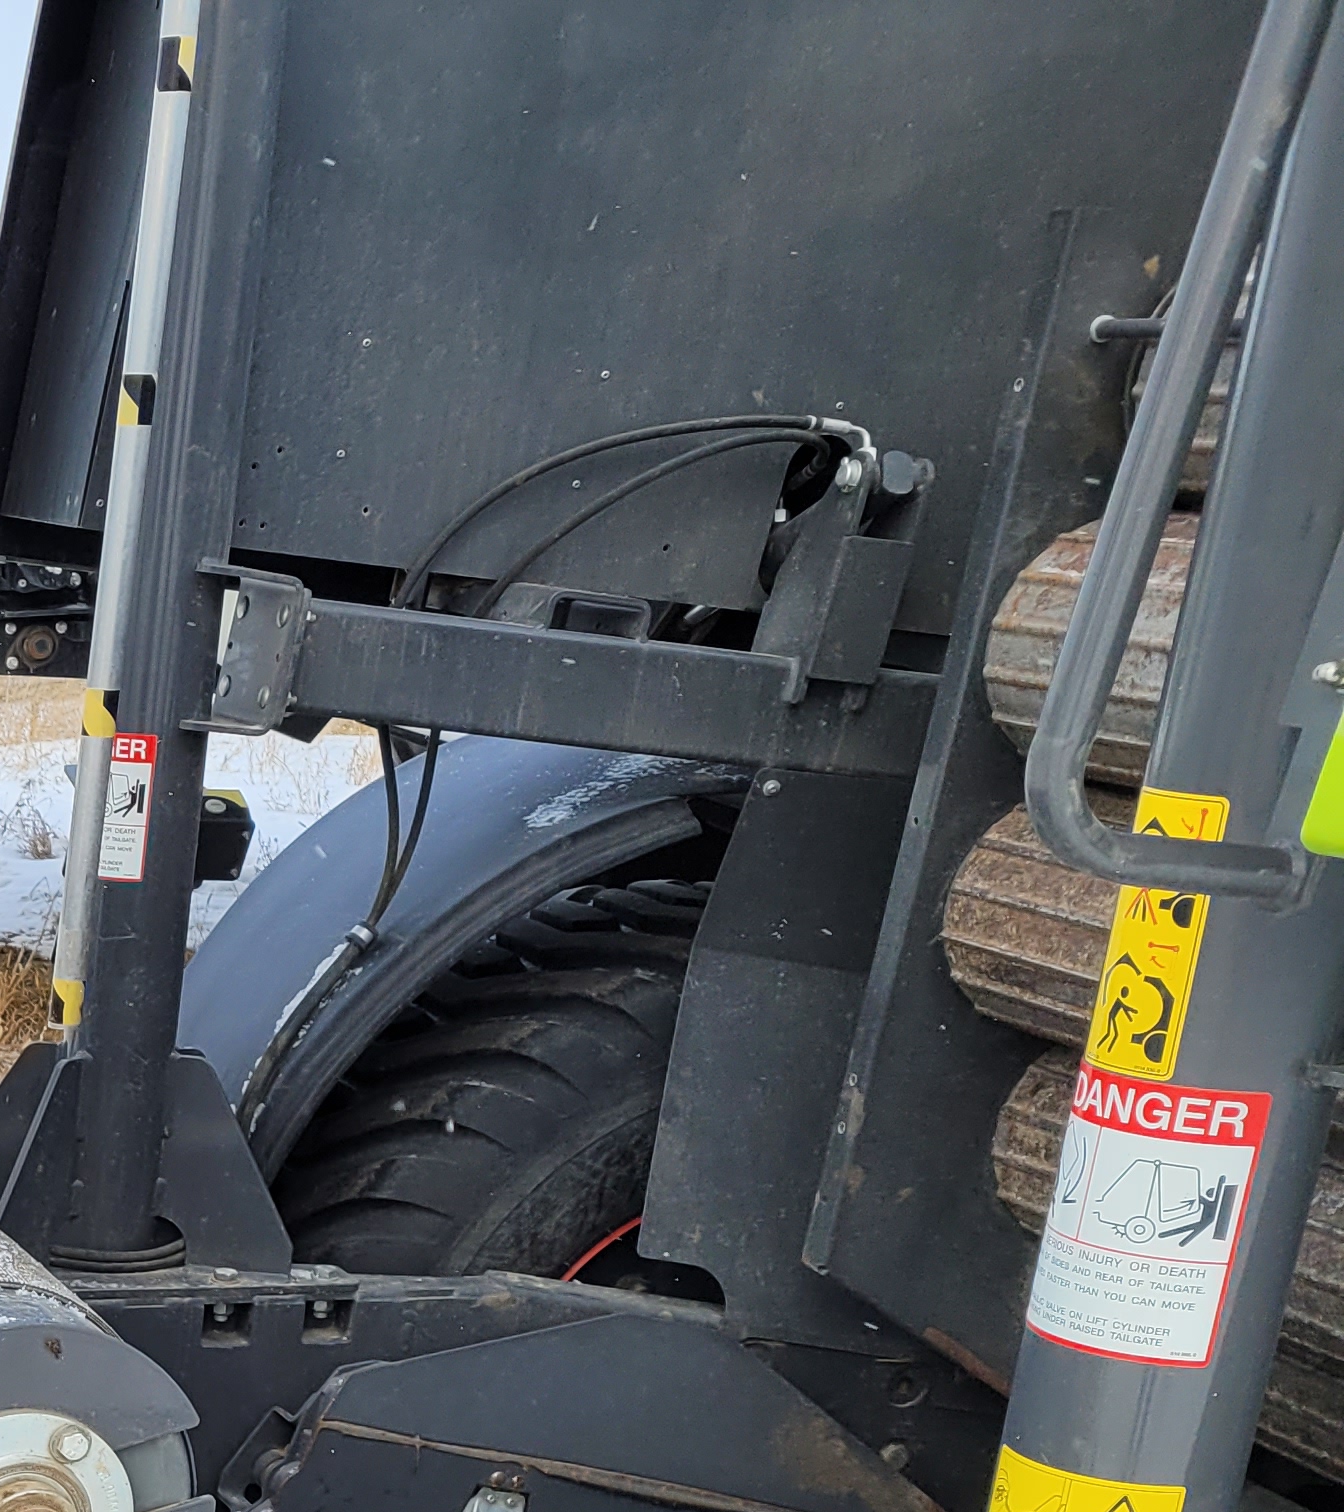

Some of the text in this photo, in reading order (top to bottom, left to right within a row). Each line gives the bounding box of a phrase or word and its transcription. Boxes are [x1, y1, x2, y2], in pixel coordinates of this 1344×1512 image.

[1074, 1072, 1249, 1138] DANGER
[1072, 1265, 1091, 1277] AND
[1095, 1271, 1123, 1284] REAR
[1128, 1278, 1144, 1288] OF
[1078, 1249, 1123, 1269] INJURY
[1129, 1261, 1151, 1273] OR
[1158, 1265, 1206, 1279] DEATH
[1074, 1282, 1099, 1296] THAN
[1103, 1290, 1126, 1302] YOU
[1131, 1296, 1156, 1307] CAN
[1161, 1301, 1196, 1311] MOVE
[1069, 1310, 1083, 1320] ON
[1086, 1315, 1109, 1326] LIFT
[1112, 1321, 1170, 1336] CYLINDER
[1069, 1322, 1105, 1337] RAISED
[1110, 1331, 1163, 1347] TAILGATE
